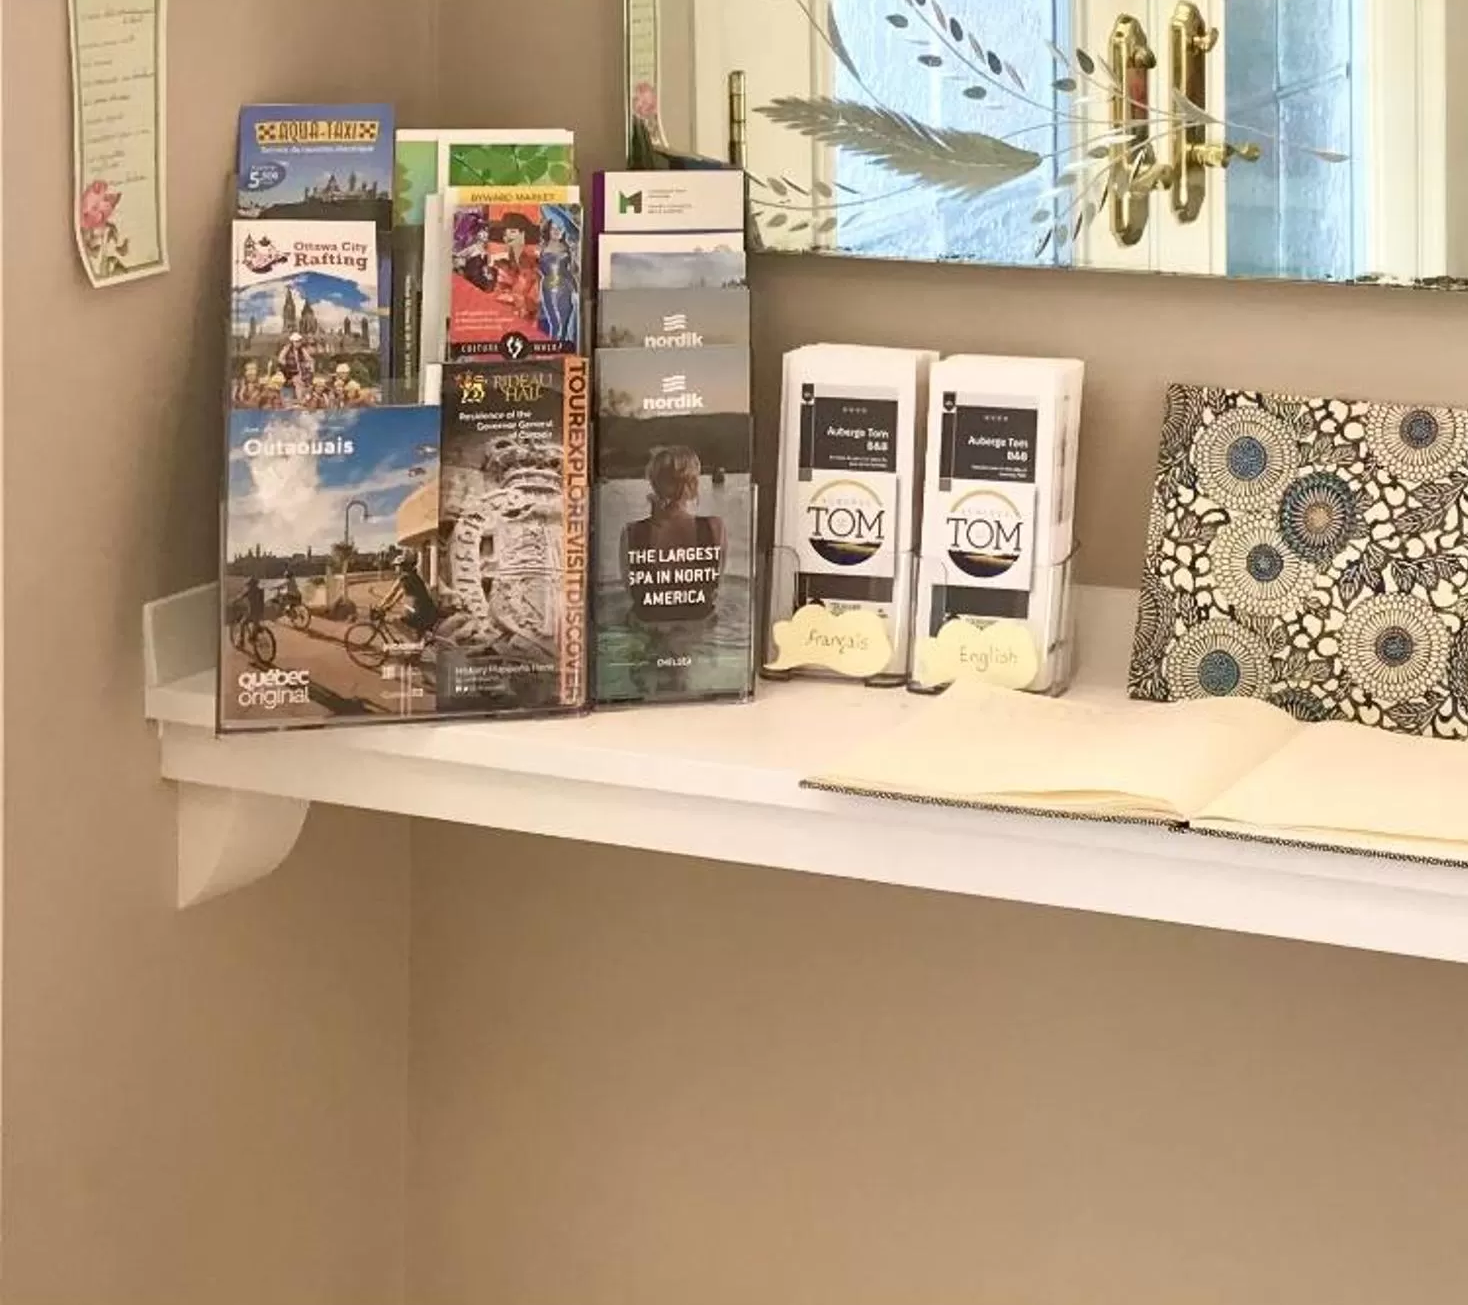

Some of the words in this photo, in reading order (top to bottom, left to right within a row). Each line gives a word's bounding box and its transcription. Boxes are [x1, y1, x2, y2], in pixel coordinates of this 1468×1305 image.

[279, 121, 358, 142] AQUA-TAXI
[293, 242, 338, 252] Ottawa
[341, 242, 368, 254] City
[294, 253, 369, 270] Rafting
[644, 332, 704, 348] nordik
[493, 372, 553, 390] RIDEAU
[643, 393, 705, 411] nordik
[243, 436, 355, 456] Outaouais
[807, 506, 885, 539] TOM
[947, 517, 1024, 551] TOM
[628, 549, 656, 564] THE
[658, 547, 721, 563] LARGEST
[628, 570, 653, 585] SPA
[657, 570, 671, 584] IN
[674, 569, 720, 584] NORTH
[643, 590, 706, 606] AMERICA
[960, 644, 1018, 672] English
[238, 669, 310, 688] québec
[238, 687, 310, 709] original
